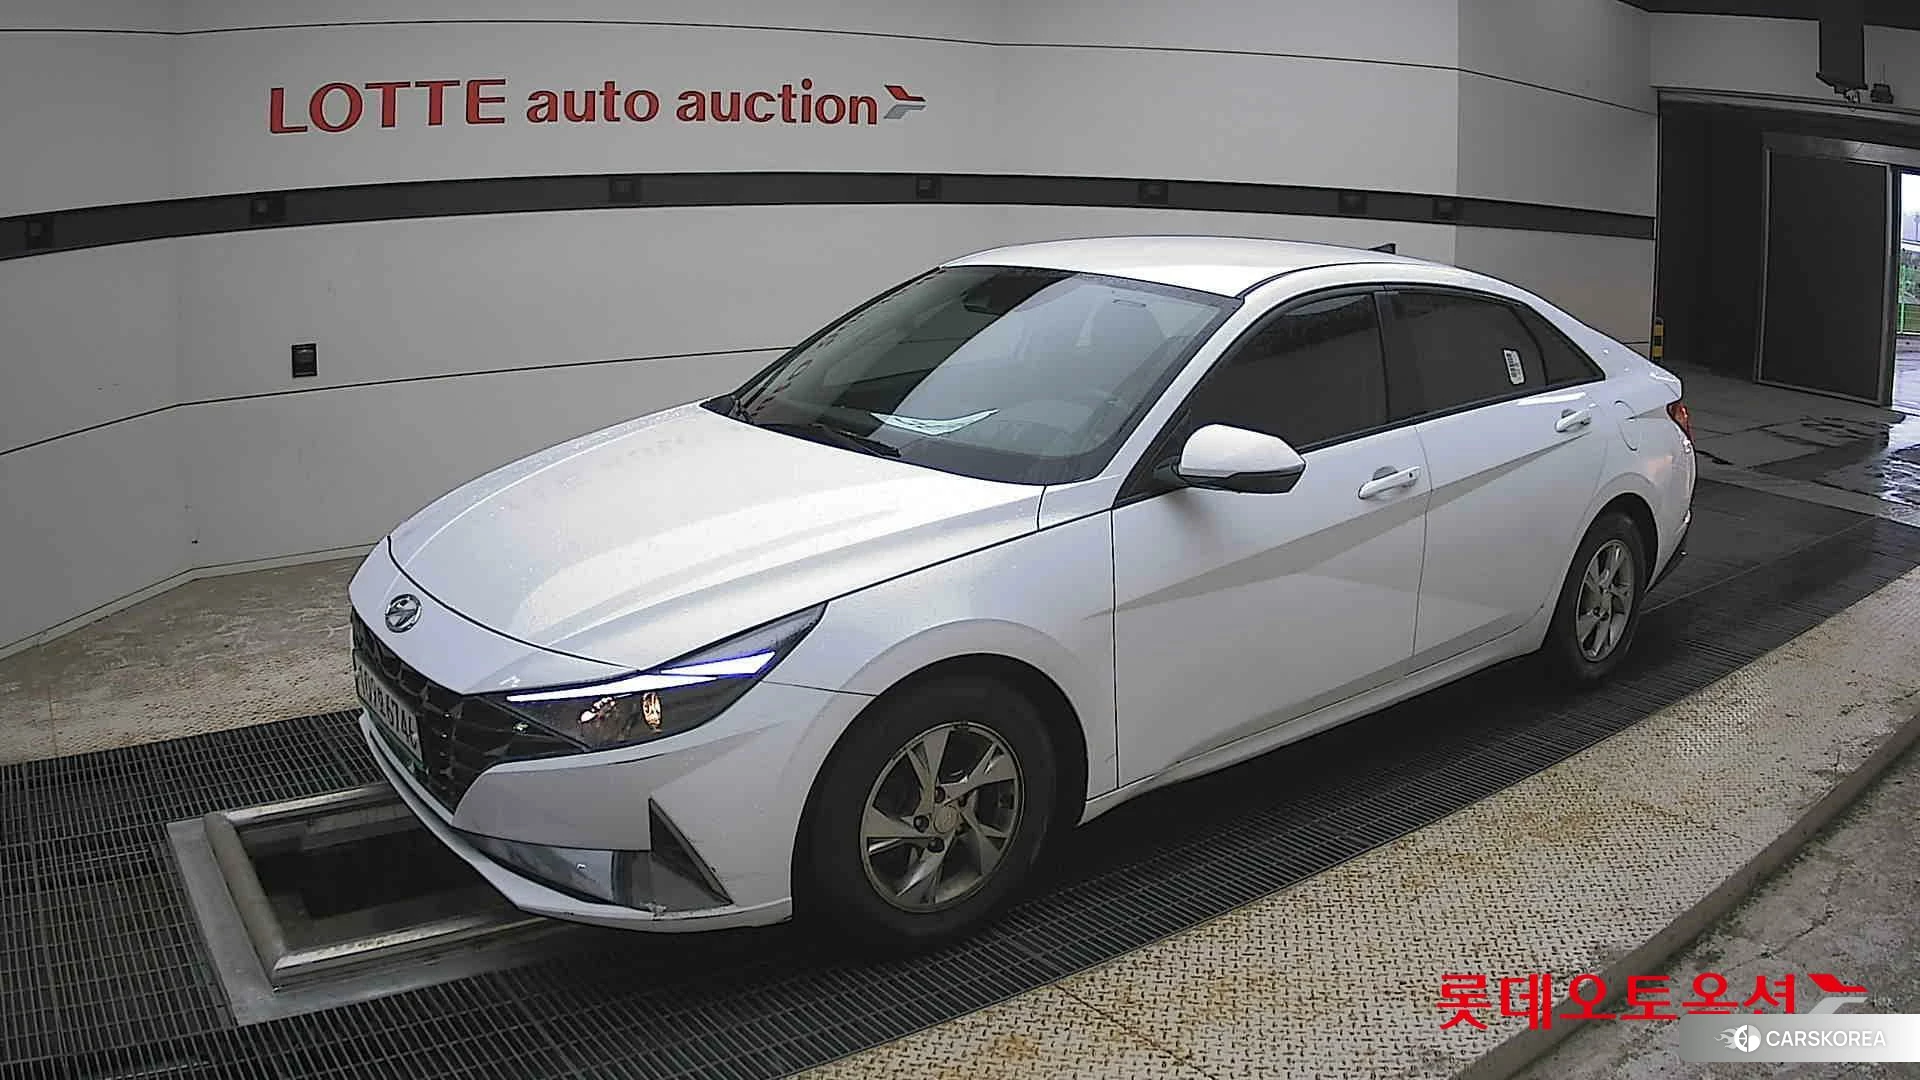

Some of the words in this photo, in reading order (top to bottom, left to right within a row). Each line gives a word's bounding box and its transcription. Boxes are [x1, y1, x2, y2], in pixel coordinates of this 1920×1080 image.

[270, 79, 506, 134] LOTTE
[526, 81, 661, 124] auto
[676, 78, 879, 125] auction
